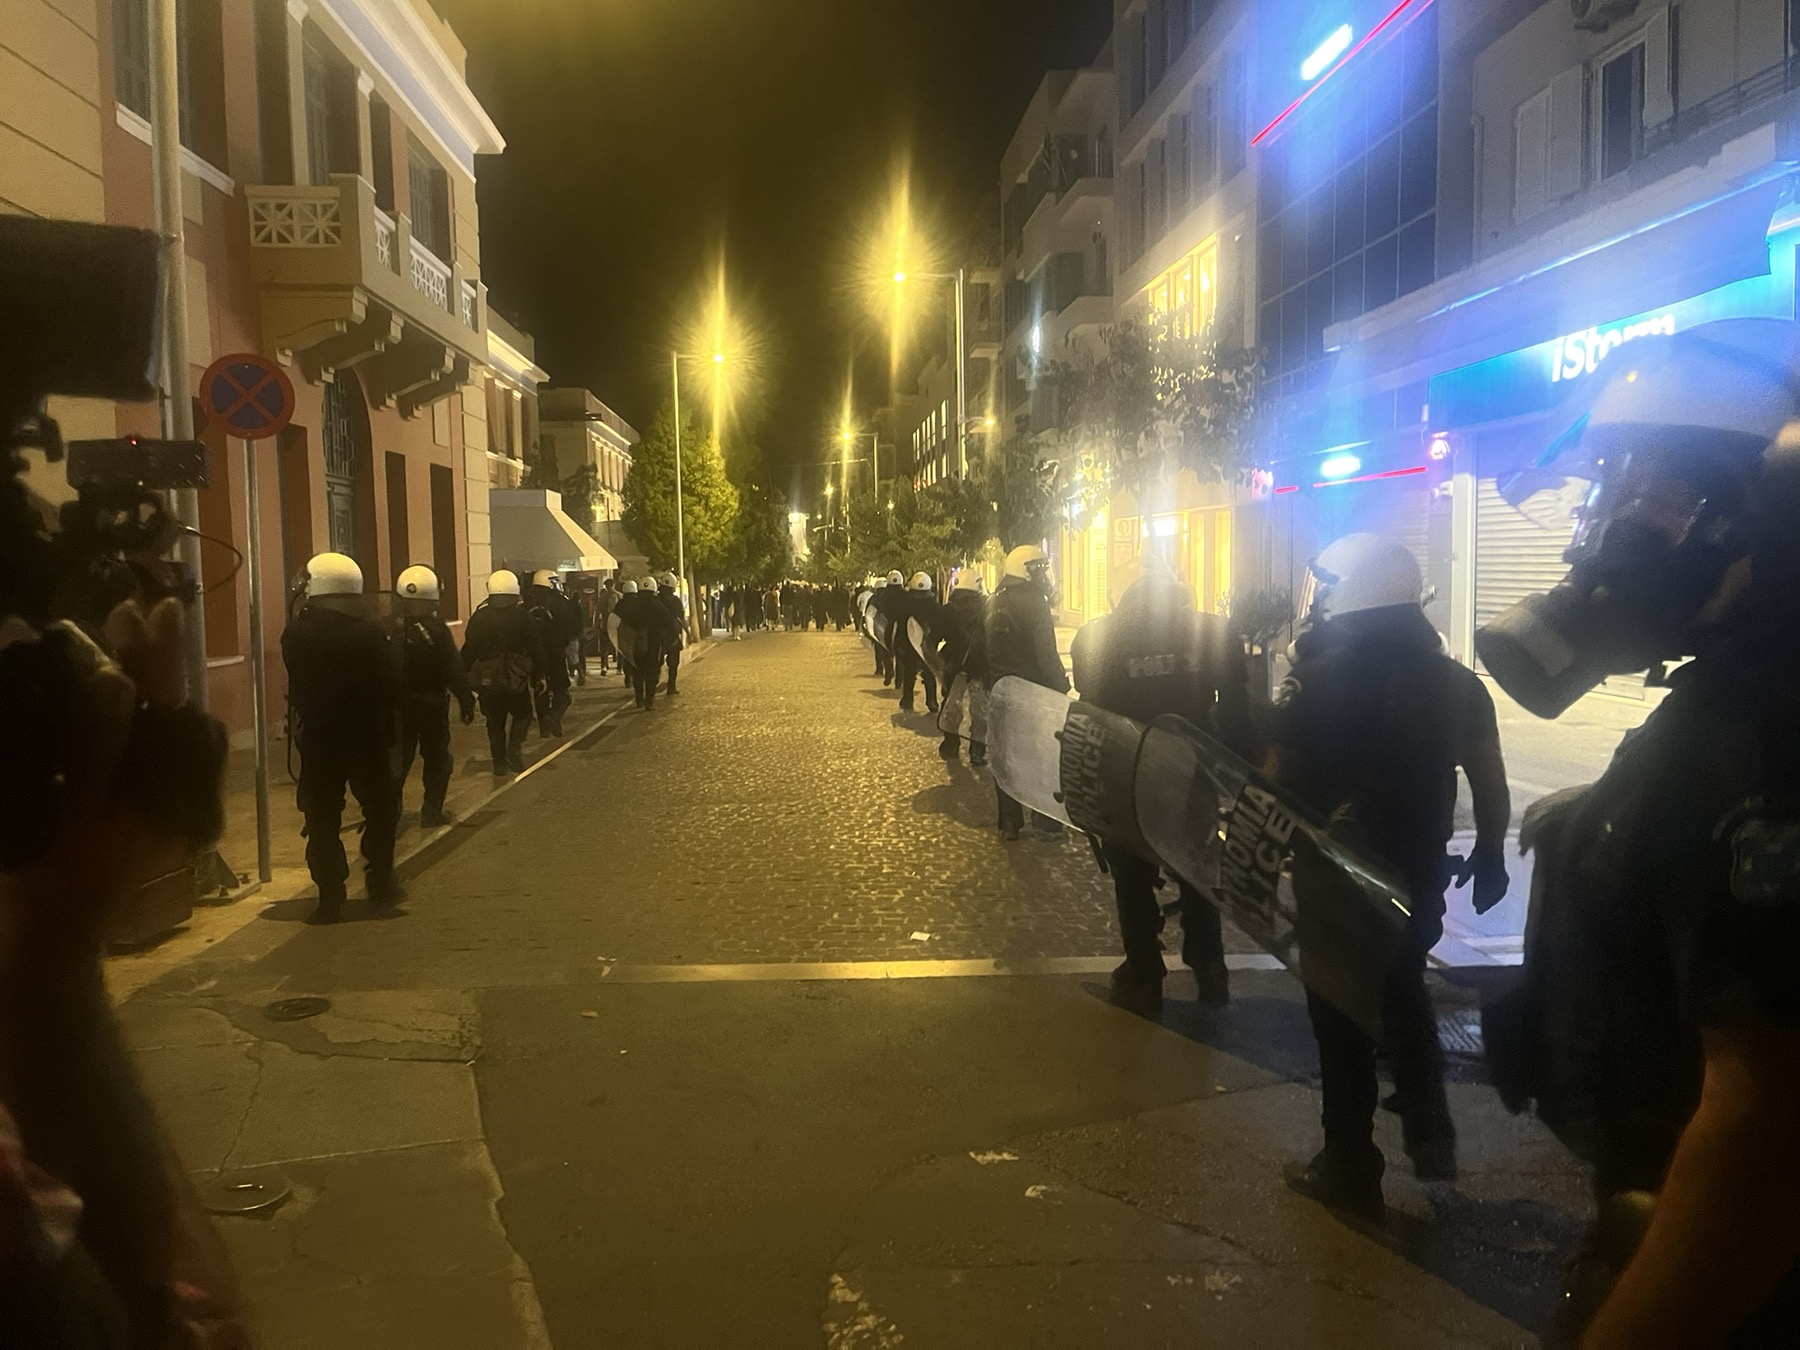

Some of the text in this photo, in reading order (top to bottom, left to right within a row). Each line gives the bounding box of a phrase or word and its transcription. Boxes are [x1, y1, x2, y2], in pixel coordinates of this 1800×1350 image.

[1061, 713, 1091, 828] TYNOMIA
[1081, 722, 1108, 828] OLICE
[1216, 784, 1277, 910] YNOMIA
